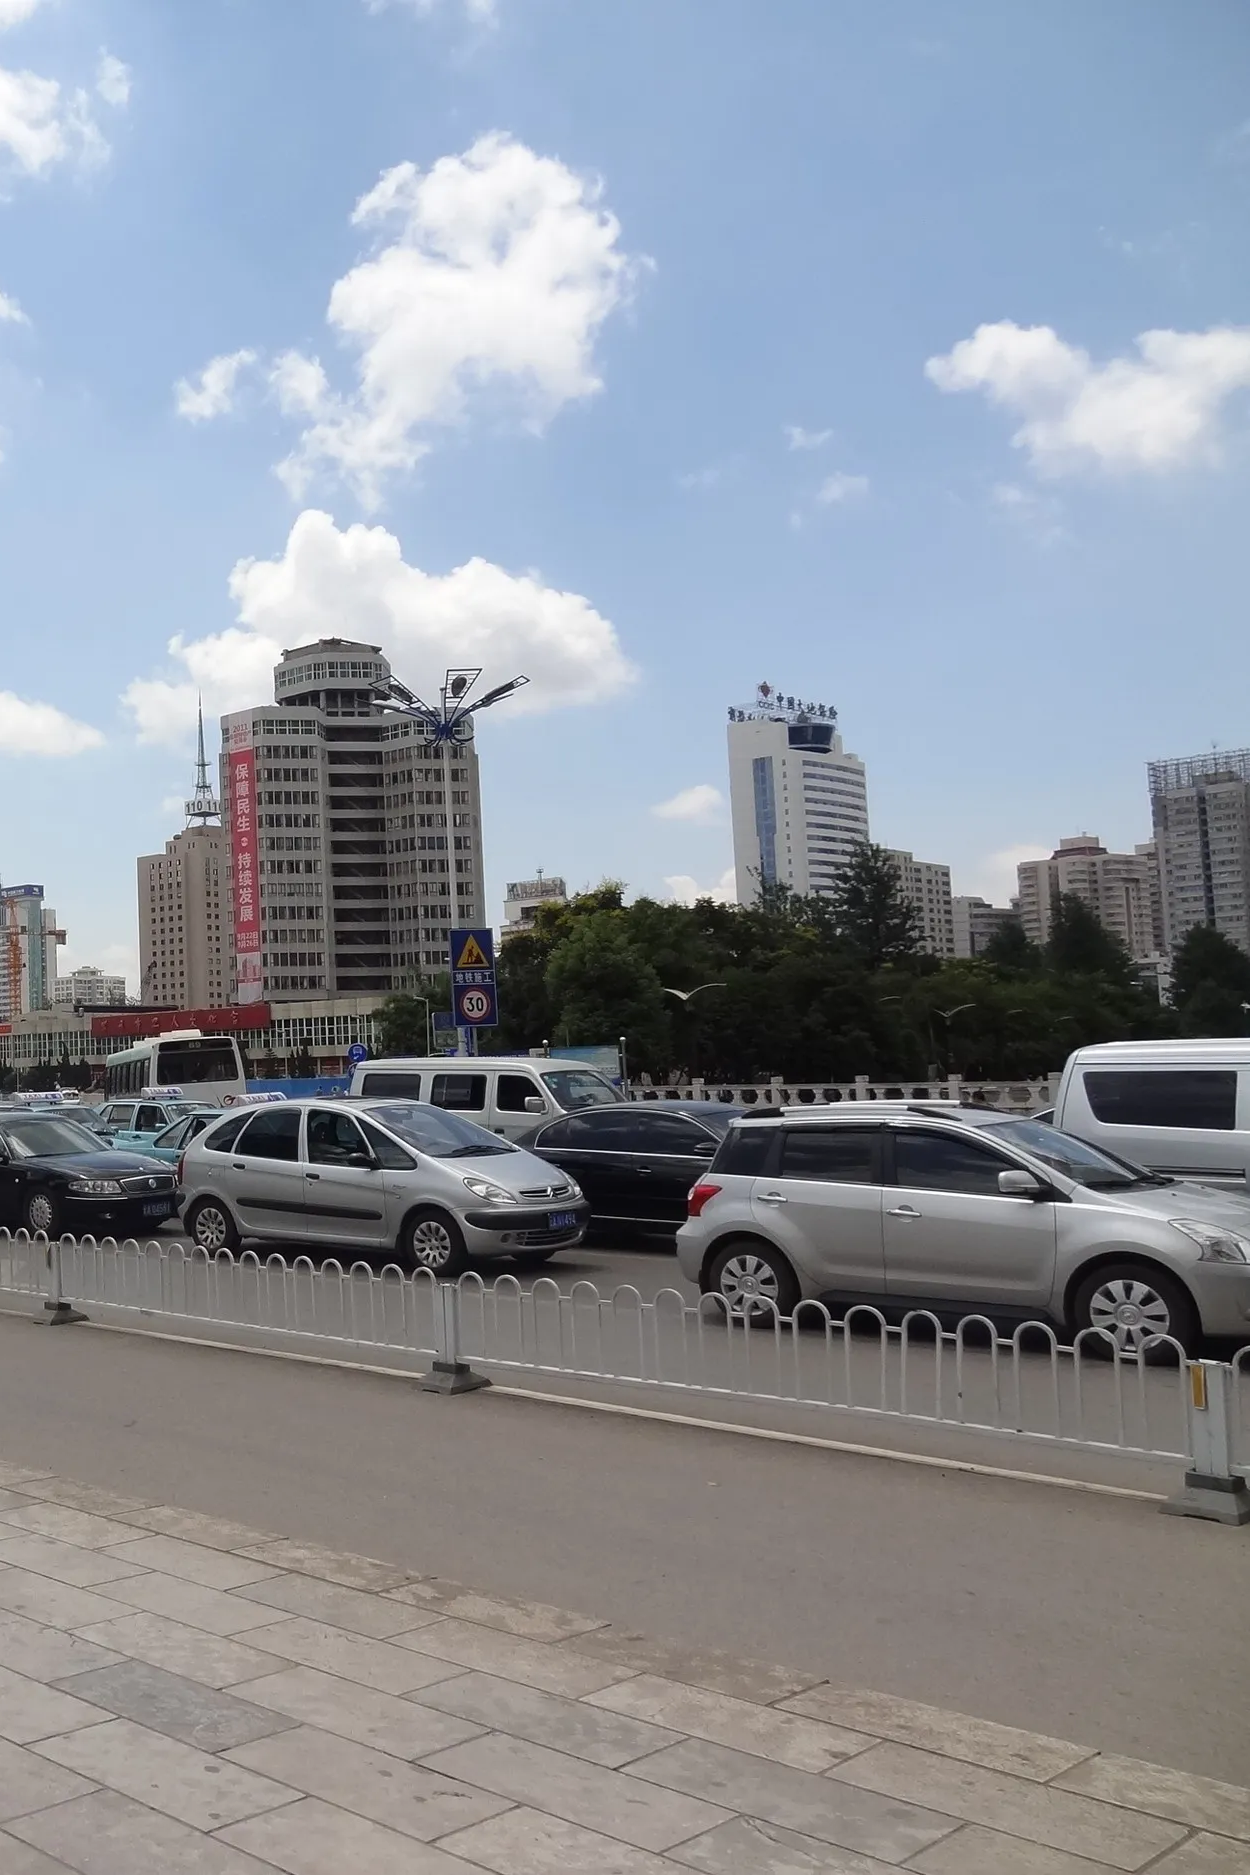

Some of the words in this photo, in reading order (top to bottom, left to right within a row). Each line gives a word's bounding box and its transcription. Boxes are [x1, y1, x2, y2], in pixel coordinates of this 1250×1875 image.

[235, 763, 250, 832] 保障民生
[186, 801, 202, 813] 110
[237, 853, 253, 921] 持续发展
[455, 972, 491, 983] 地铁施工
[466, 997, 484, 1012] 30
